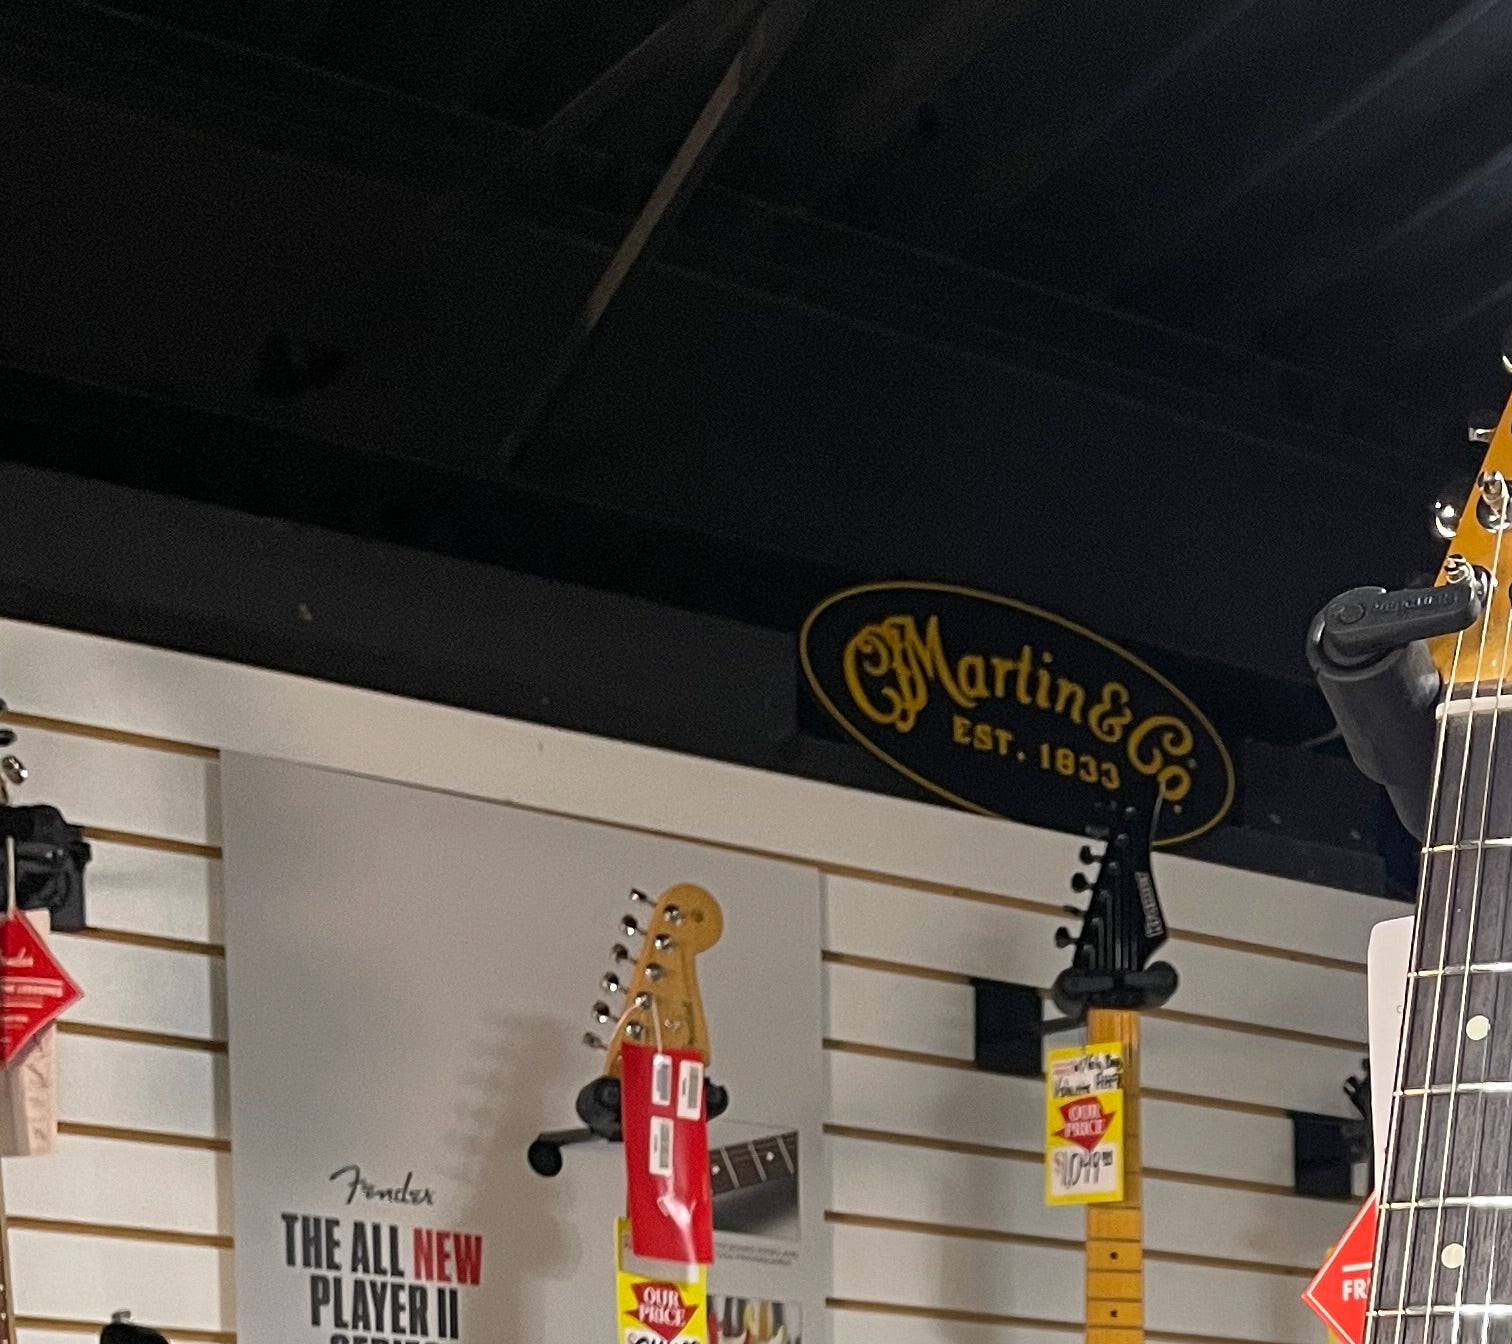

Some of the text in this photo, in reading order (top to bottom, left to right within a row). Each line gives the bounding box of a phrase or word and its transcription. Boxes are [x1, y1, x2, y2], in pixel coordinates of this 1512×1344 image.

[952, 714, 1121, 790] EST. 1833
[1064, 1119, 1107, 1139] PRICE
[1068, 1103, 1101, 1122] OUR
[329, 1164, 434, 1206] Fender
[281, 1211, 483, 1286] THE ALL NEW
[309, 1274, 460, 1340] PLAYER II
[643, 1286, 680, 1305] OUR
[638, 1302, 687, 1327] PRICE
